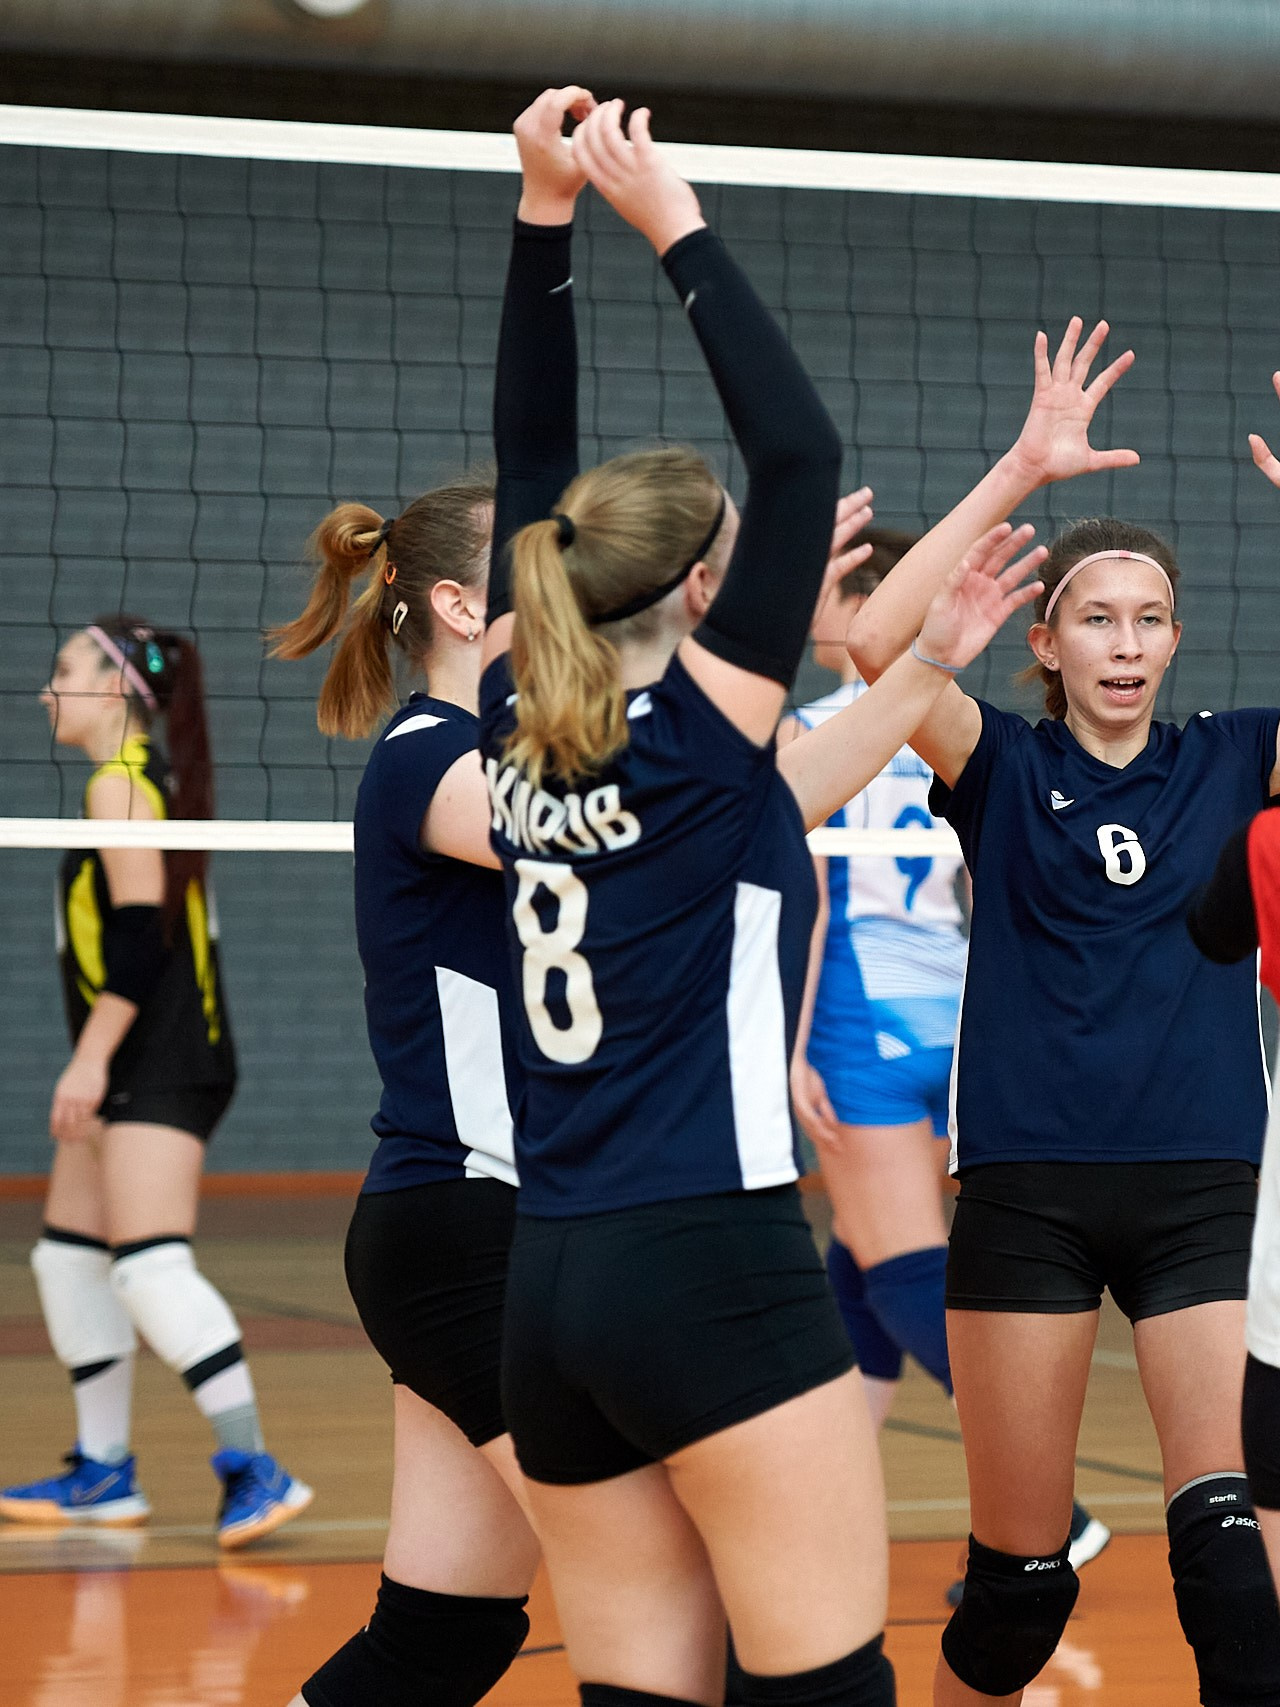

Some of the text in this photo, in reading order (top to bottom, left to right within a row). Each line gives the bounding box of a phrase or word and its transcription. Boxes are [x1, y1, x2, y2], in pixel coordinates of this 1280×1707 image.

[1097, 823, 1146, 886] 6
[513, 858, 603, 1064] 8
[1209, 1493, 1238, 1504] starfit
